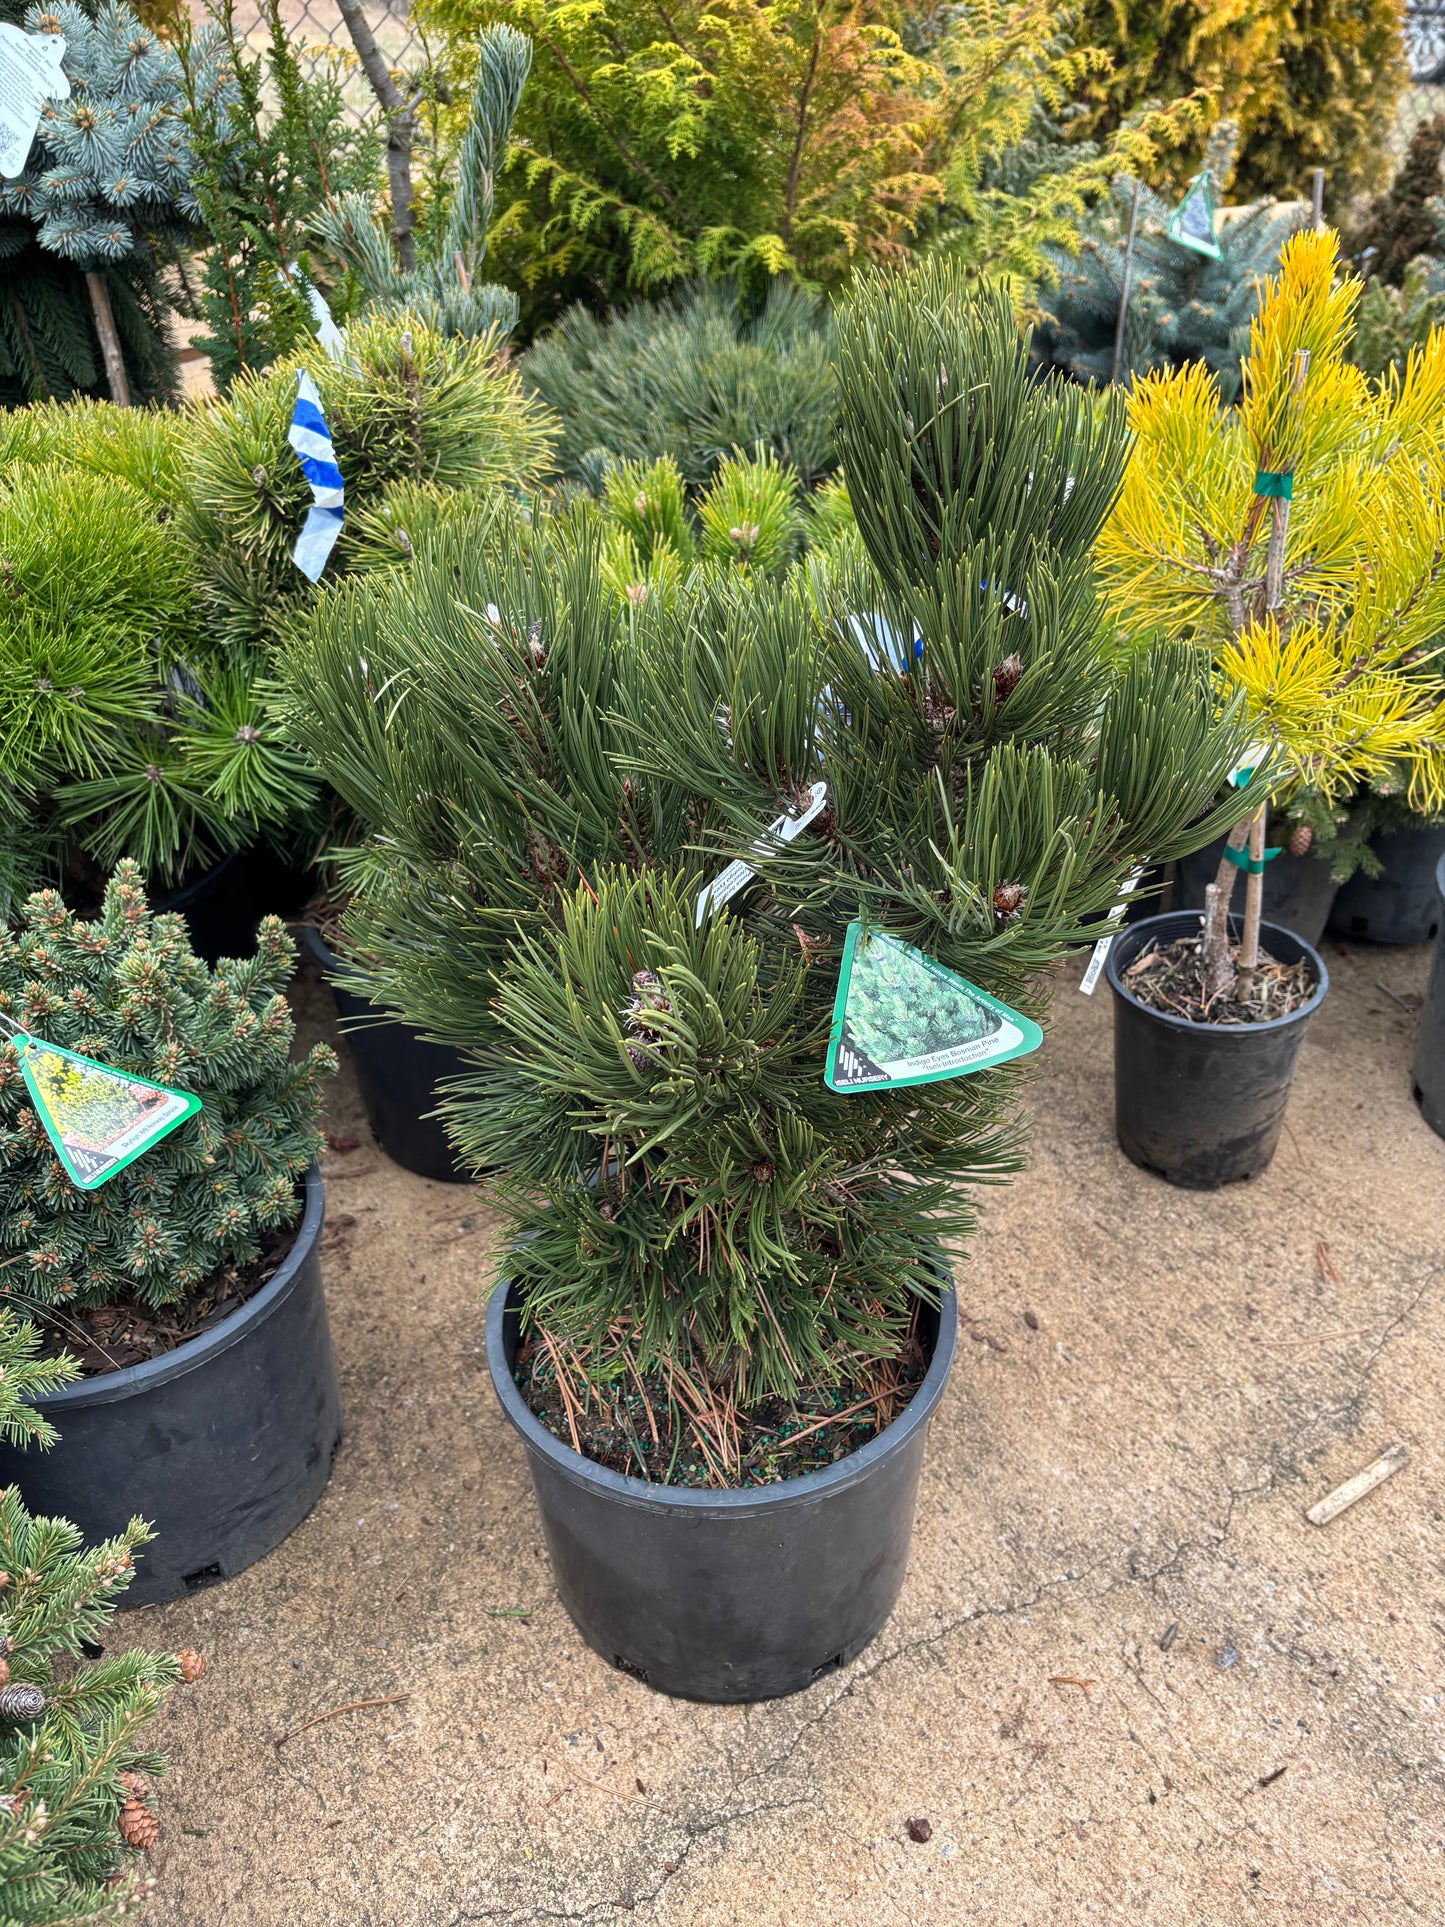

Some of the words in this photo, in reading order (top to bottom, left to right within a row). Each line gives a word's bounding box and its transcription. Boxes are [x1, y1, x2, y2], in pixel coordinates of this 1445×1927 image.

[905, 949, 924, 964] Beauty
[929, 964, 948, 980] Nature
[947, 976, 965, 990] Meets
[964, 987, 975, 997] The
[974, 994, 996, 1010] Artistry
[906, 1057, 930, 1067] Indigo
[931, 1052, 949, 1062] Eyes
[950, 1042, 980, 1056] Bosnian
[981, 1036, 999, 1047] Pine
[834, 1077, 853, 1085] ISELI
[852, 1074, 887, 1083] NURSERY
